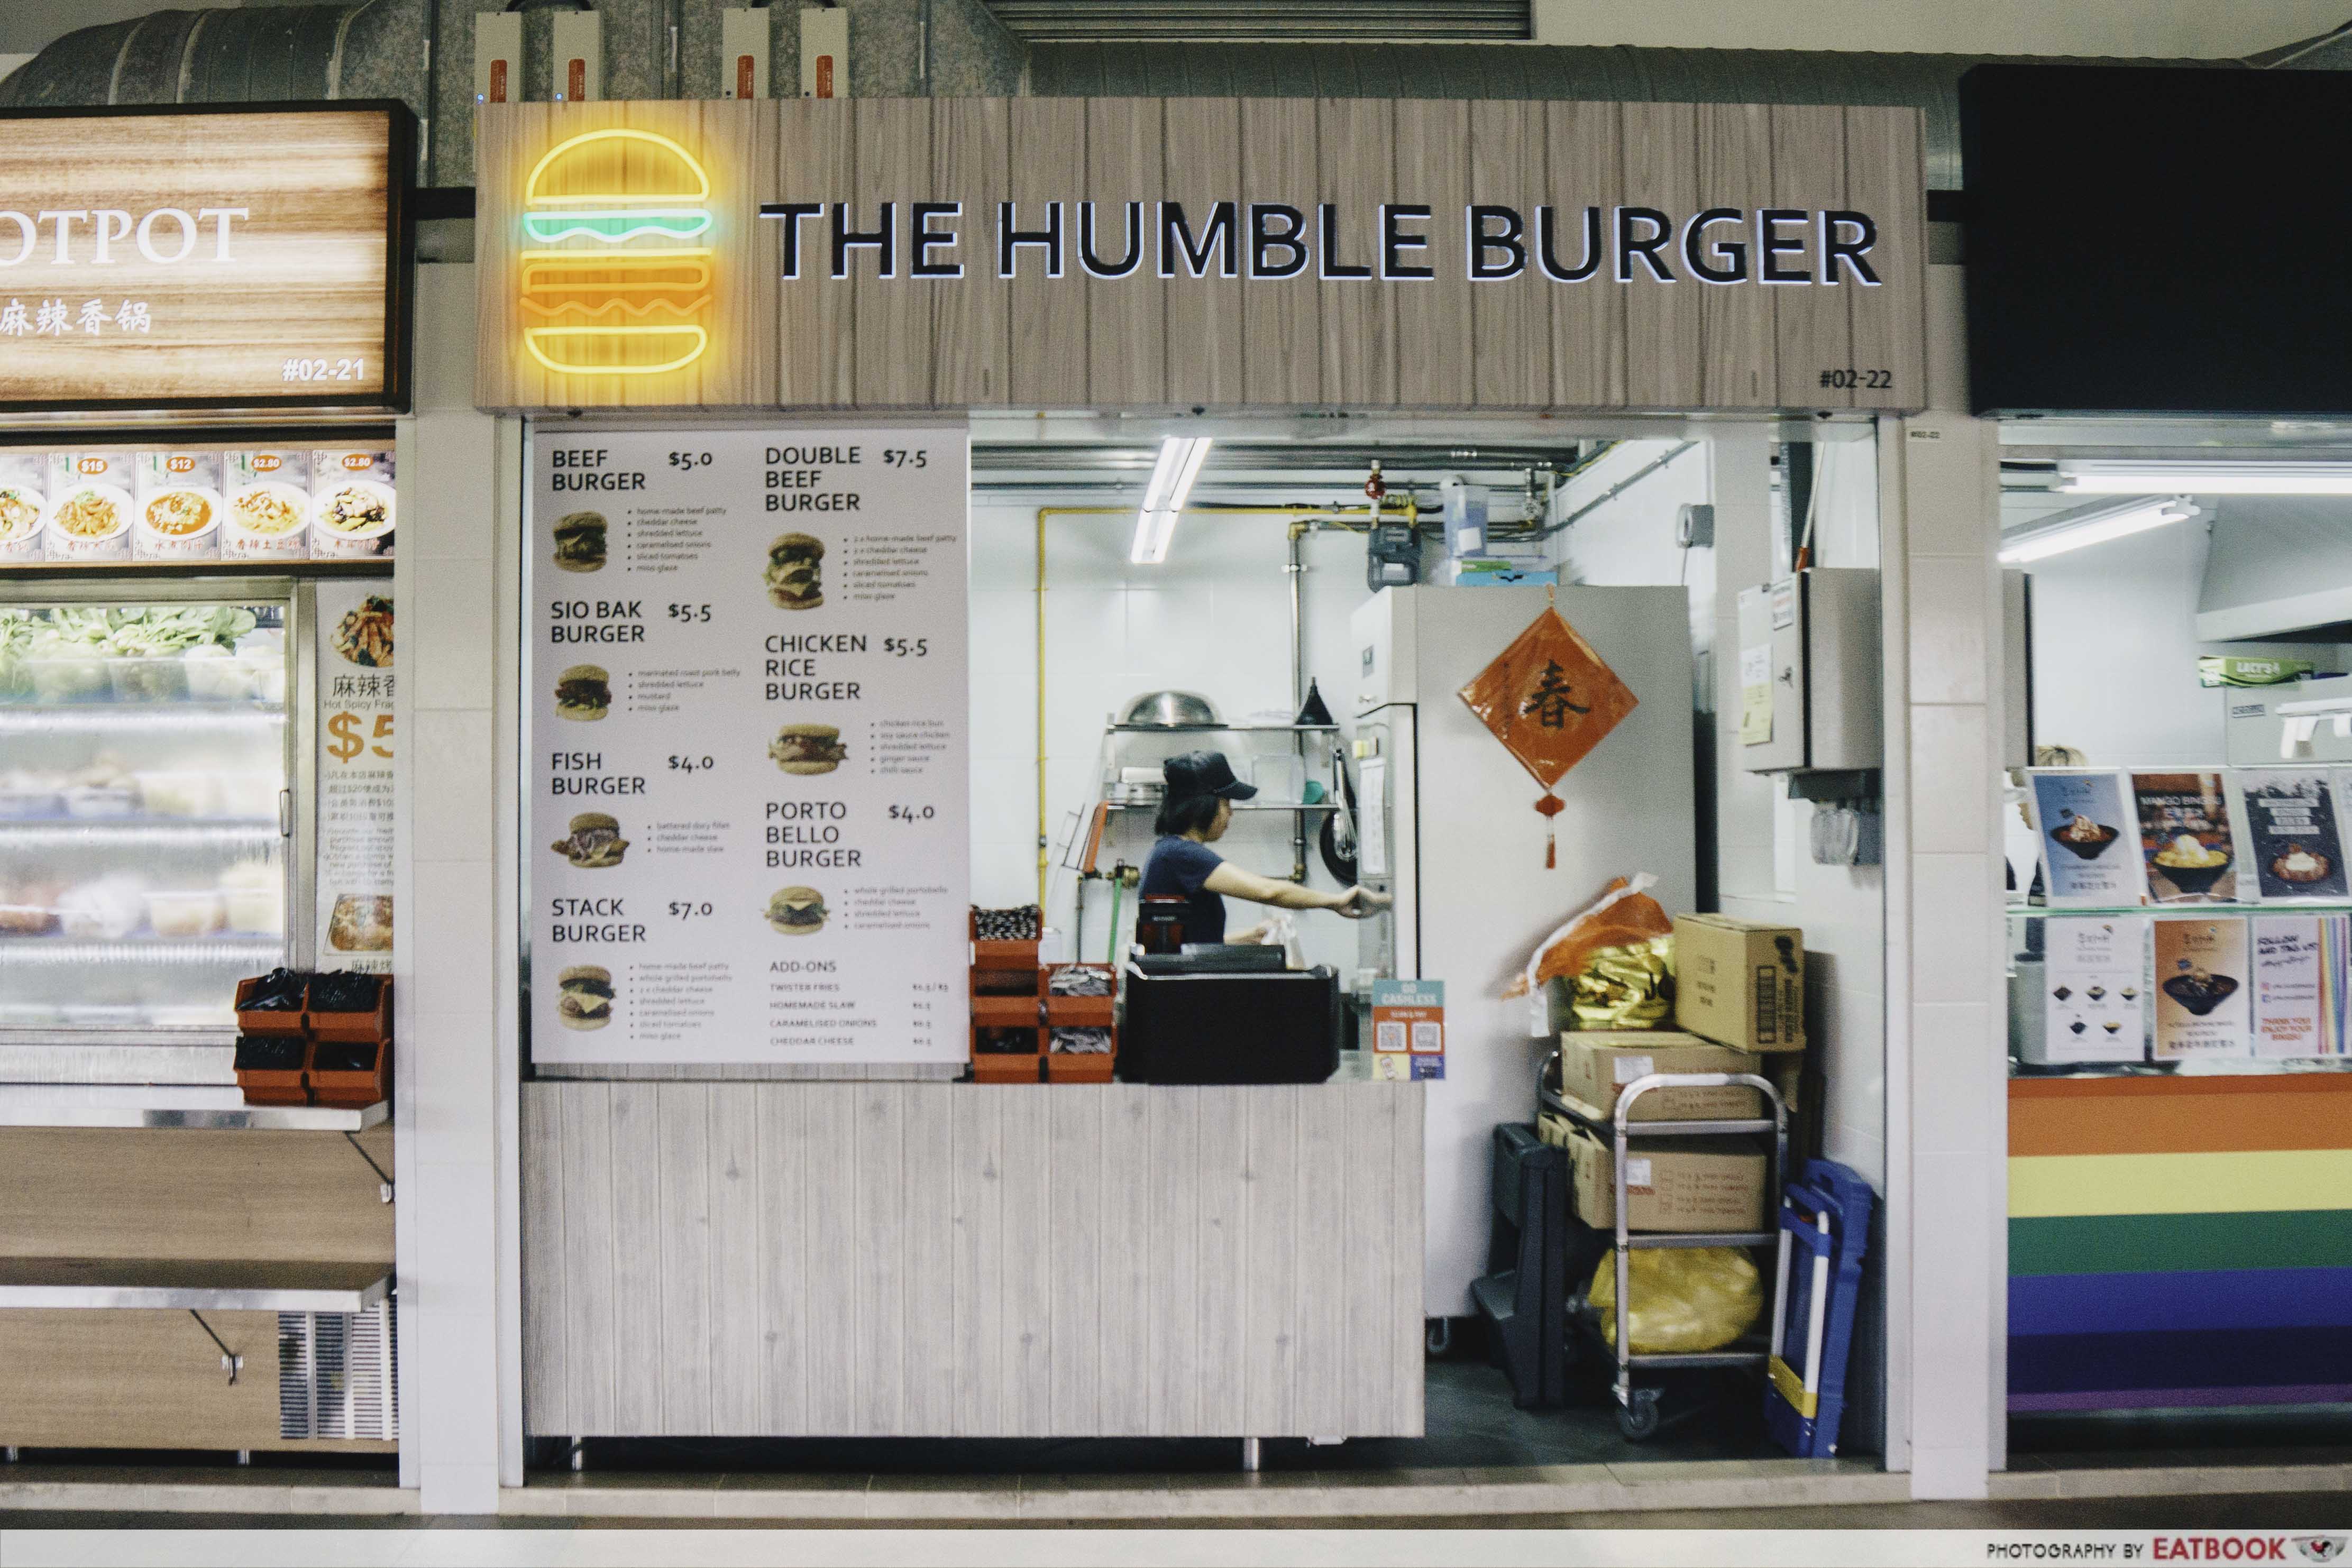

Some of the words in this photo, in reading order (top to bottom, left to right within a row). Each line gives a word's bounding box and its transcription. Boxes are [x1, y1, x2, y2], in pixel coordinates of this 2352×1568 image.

[759, 201, 964, 280] THE
[997, 201, 1434, 281] HUMBLE
[1466, 205, 1882, 286] BURGER
[0, 297, 152, 336] 麻辣香锅
[282, 357, 364, 382] #02-21
[1819, 370, 1892, 389] #02-22
[81, 460, 104, 472] $15
[169, 459, 191, 470] $12
[552, 450, 608, 467] BEEF
[669, 452, 712, 470] $5.0
[766, 446, 862, 465] DOUBLE
[883, 450, 927, 469] $7.5
[552, 472, 646, 491] BURGER
[765, 470, 822, 488] BEEF
[765, 493, 861, 512] BURGER
[551, 601, 589, 619] SIO
[596, 601, 643, 619] BAK
[668, 603, 711, 622] $5.5
[551, 625, 645, 643] BURGER
[765, 635, 867, 653] CHICKEN
[883, 638, 928, 657] $5.5
[765, 658, 816, 677] RICE
[765, 682, 862, 701] BURGER
[1523, 658, 1590, 730] 春
[324, 700, 341, 709] Hot
[344, 700, 371, 711] Spicy
[327, 711, 394, 764] $5
[552, 753, 601, 771] FISH
[668, 755, 714, 773] $4.0
[552, 777, 646, 795] BURGER
[766, 802, 847, 821] PORTO
[888, 804, 935, 824] $4.0
[766, 826, 839, 845] BELLO
[766, 849, 862, 868] BURGER
[552, 898, 624, 916] STACK
[669, 901, 713, 921] $7.0
[552, 925, 647, 943] BURGER
[769, 960, 837, 973] ADD-ONS
